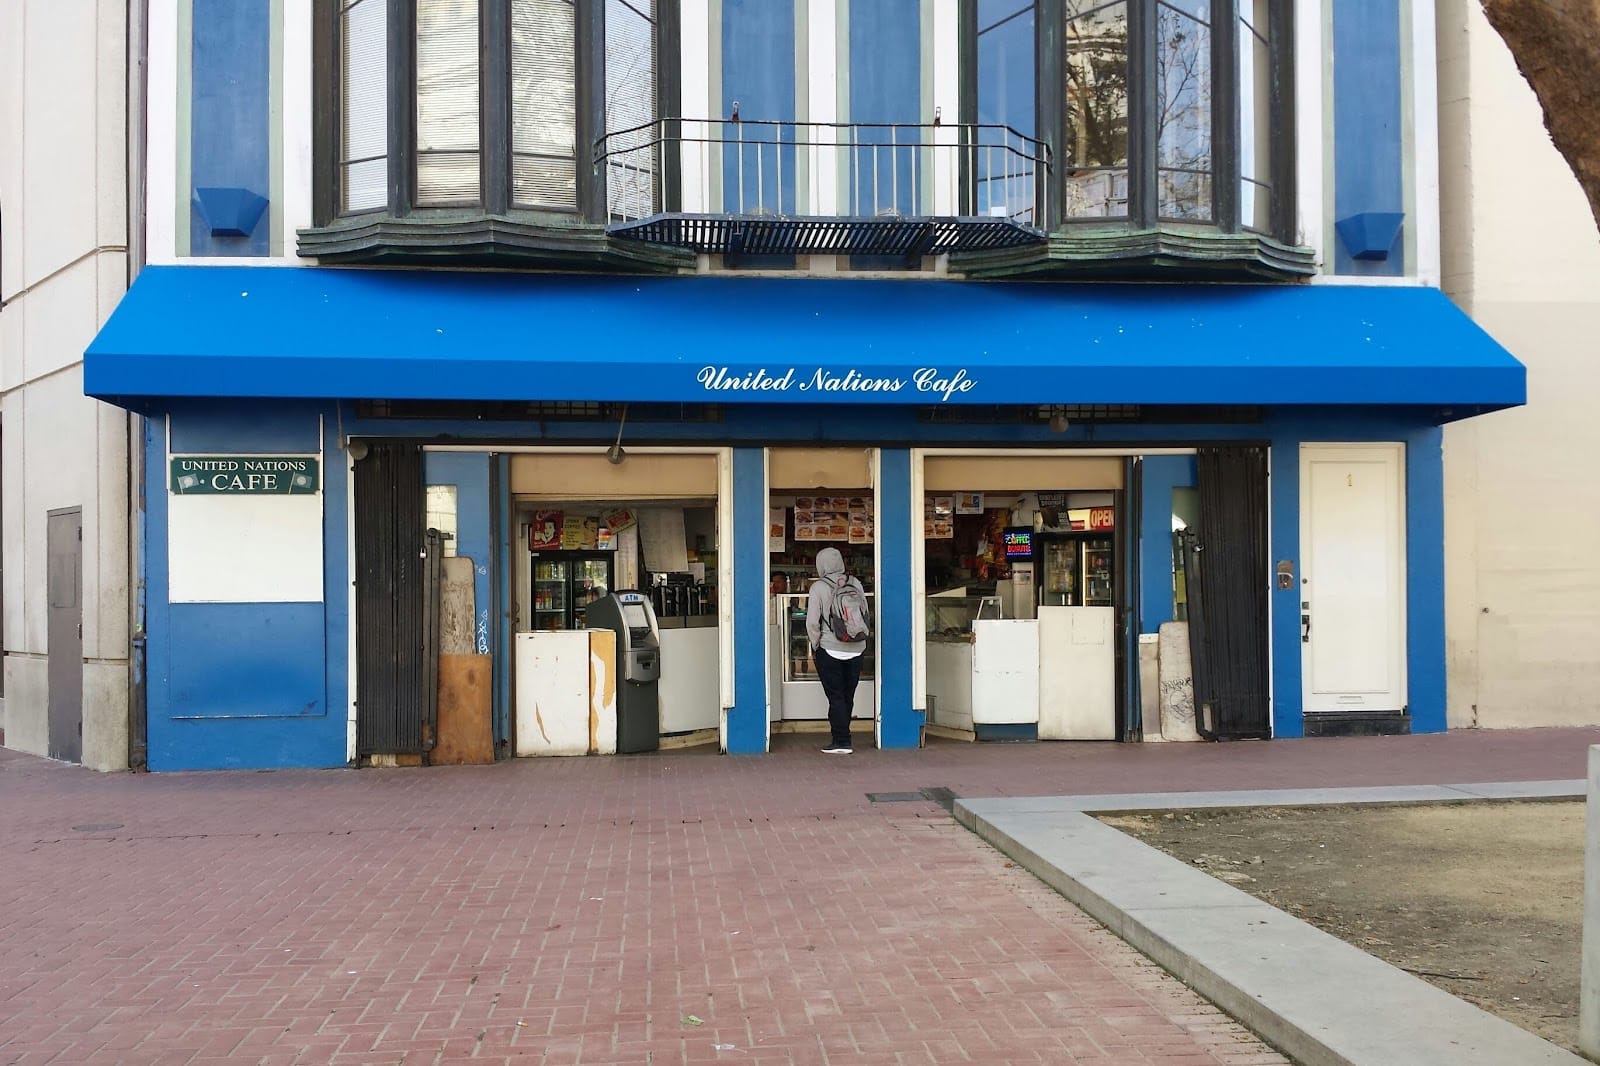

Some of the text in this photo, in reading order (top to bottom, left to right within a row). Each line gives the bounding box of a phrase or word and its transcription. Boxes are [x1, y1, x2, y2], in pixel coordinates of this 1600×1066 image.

[697, 366, 978, 402] United Nations Cafe
[182, 461, 306, 471] UNITED NATIONS
[211, 474, 278, 490] CAFE
